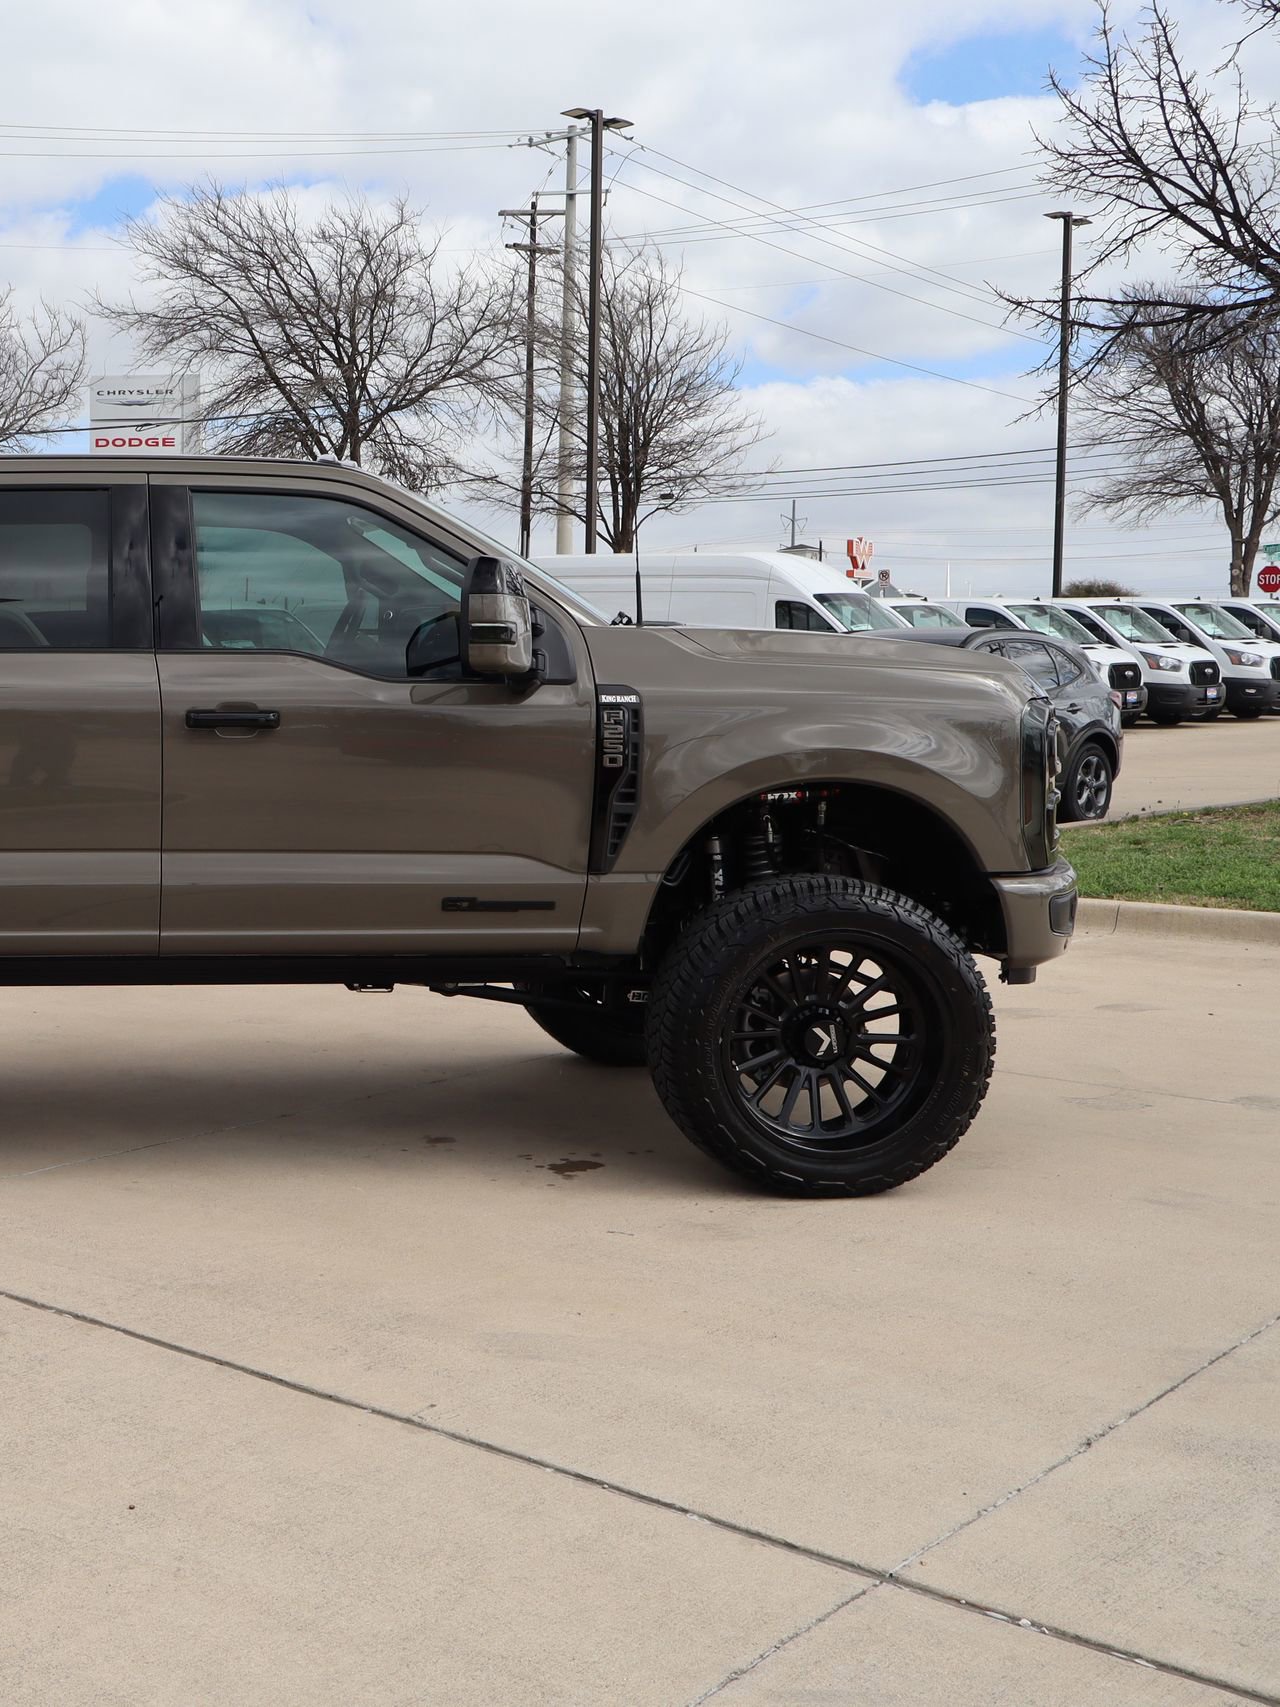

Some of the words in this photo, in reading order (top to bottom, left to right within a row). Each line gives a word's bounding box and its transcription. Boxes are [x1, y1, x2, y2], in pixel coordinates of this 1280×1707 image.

[96, 389, 174, 397] CHRYSLER
[95, 438, 175, 448] DODGE
[601, 694, 617, 703] KING
[617, 694, 637, 703] RANCH
